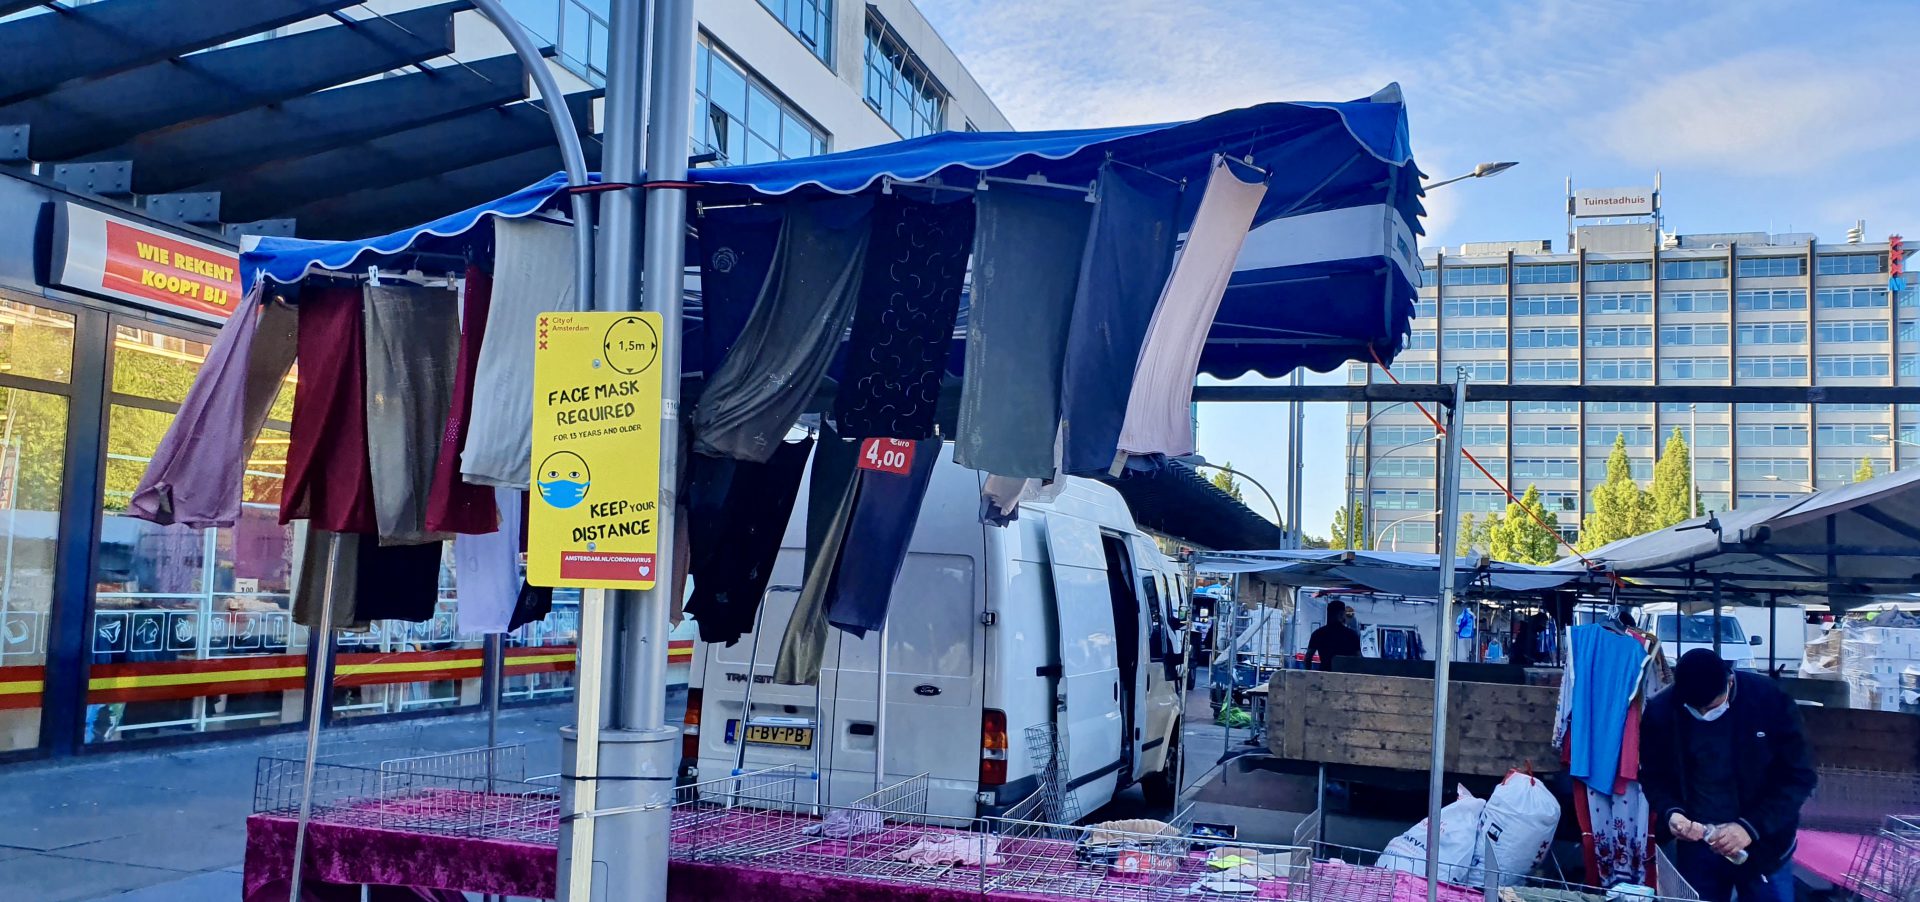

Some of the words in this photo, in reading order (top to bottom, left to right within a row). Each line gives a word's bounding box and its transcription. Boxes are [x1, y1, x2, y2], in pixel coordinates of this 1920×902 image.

[1584, 196, 1646, 206] Tuinstadhuis
[136, 241, 169, 265] WIE
[174, 252, 234, 283] REKENT
[141, 268, 201, 298] KOOPT
[203, 285, 228, 306] BIJ
[552, 316, 565, 325] City
[566, 316, 573, 324] of
[552, 324, 590, 332] Amsterdam
[618, 341, 645, 352] 1,5m
[548, 386, 590, 406] FACE
[594, 379, 640, 399] MASK
[556, 402, 635, 426] REQUIRED
[553, 433, 568, 442] FOR
[569, 432, 577, 440] 13
[578, 429, 602, 439] YEARS
[603, 427, 618, 436] AND
[619, 423, 642, 434] OLDER
[865, 439, 906, 469] 4,00
[590, 500, 628, 519] KEEP
[629, 501, 655, 513] YOUR
[572, 519, 650, 543] DISTANCE
[564, 555, 651, 563] AMSTERDAM.NL/CORONAVIRUS
